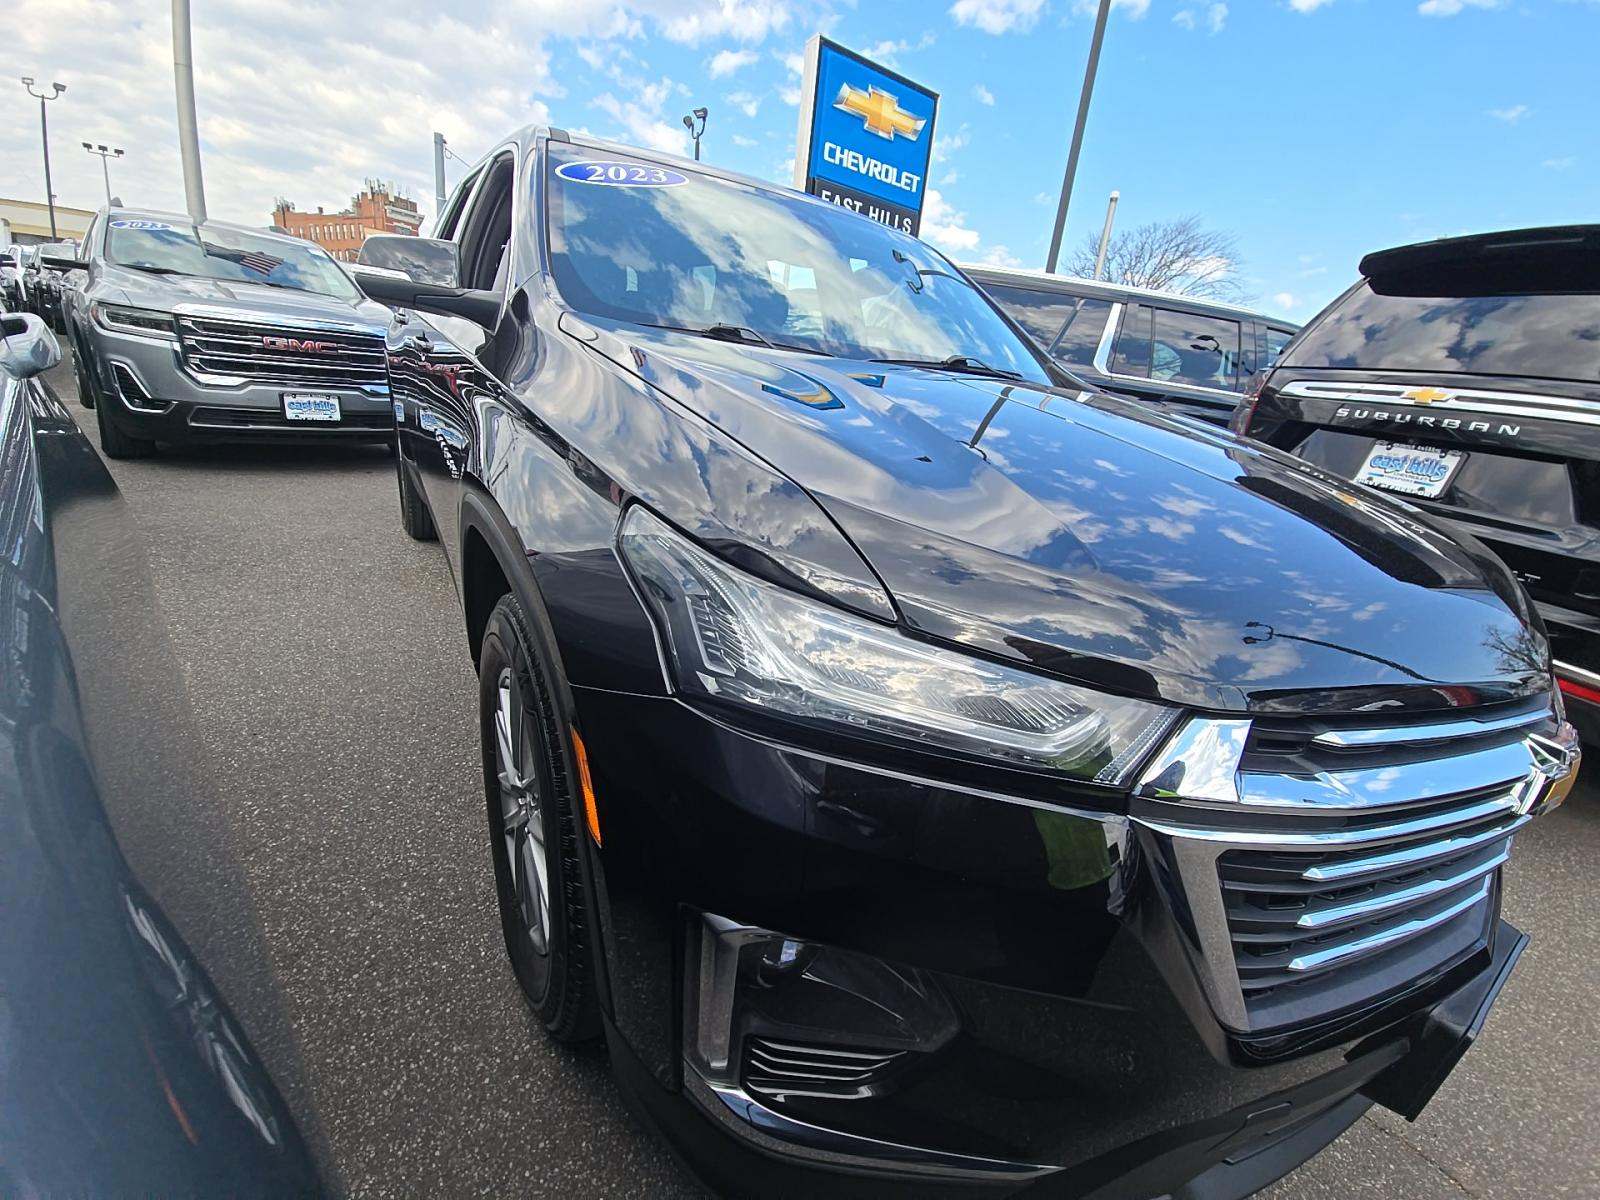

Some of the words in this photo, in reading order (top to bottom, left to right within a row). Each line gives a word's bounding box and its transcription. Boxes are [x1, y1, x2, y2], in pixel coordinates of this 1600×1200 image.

[586, 165, 668, 183] 2023
[823, 141, 921, 193] CHEVROLET
[868, 205, 912, 234] HILLS
[262, 336, 339, 355] GMC
[1335, 407, 1521, 437] SUBURBAN
[1369, 454, 1410, 473] east
[1405, 455, 1449, 481] hills
